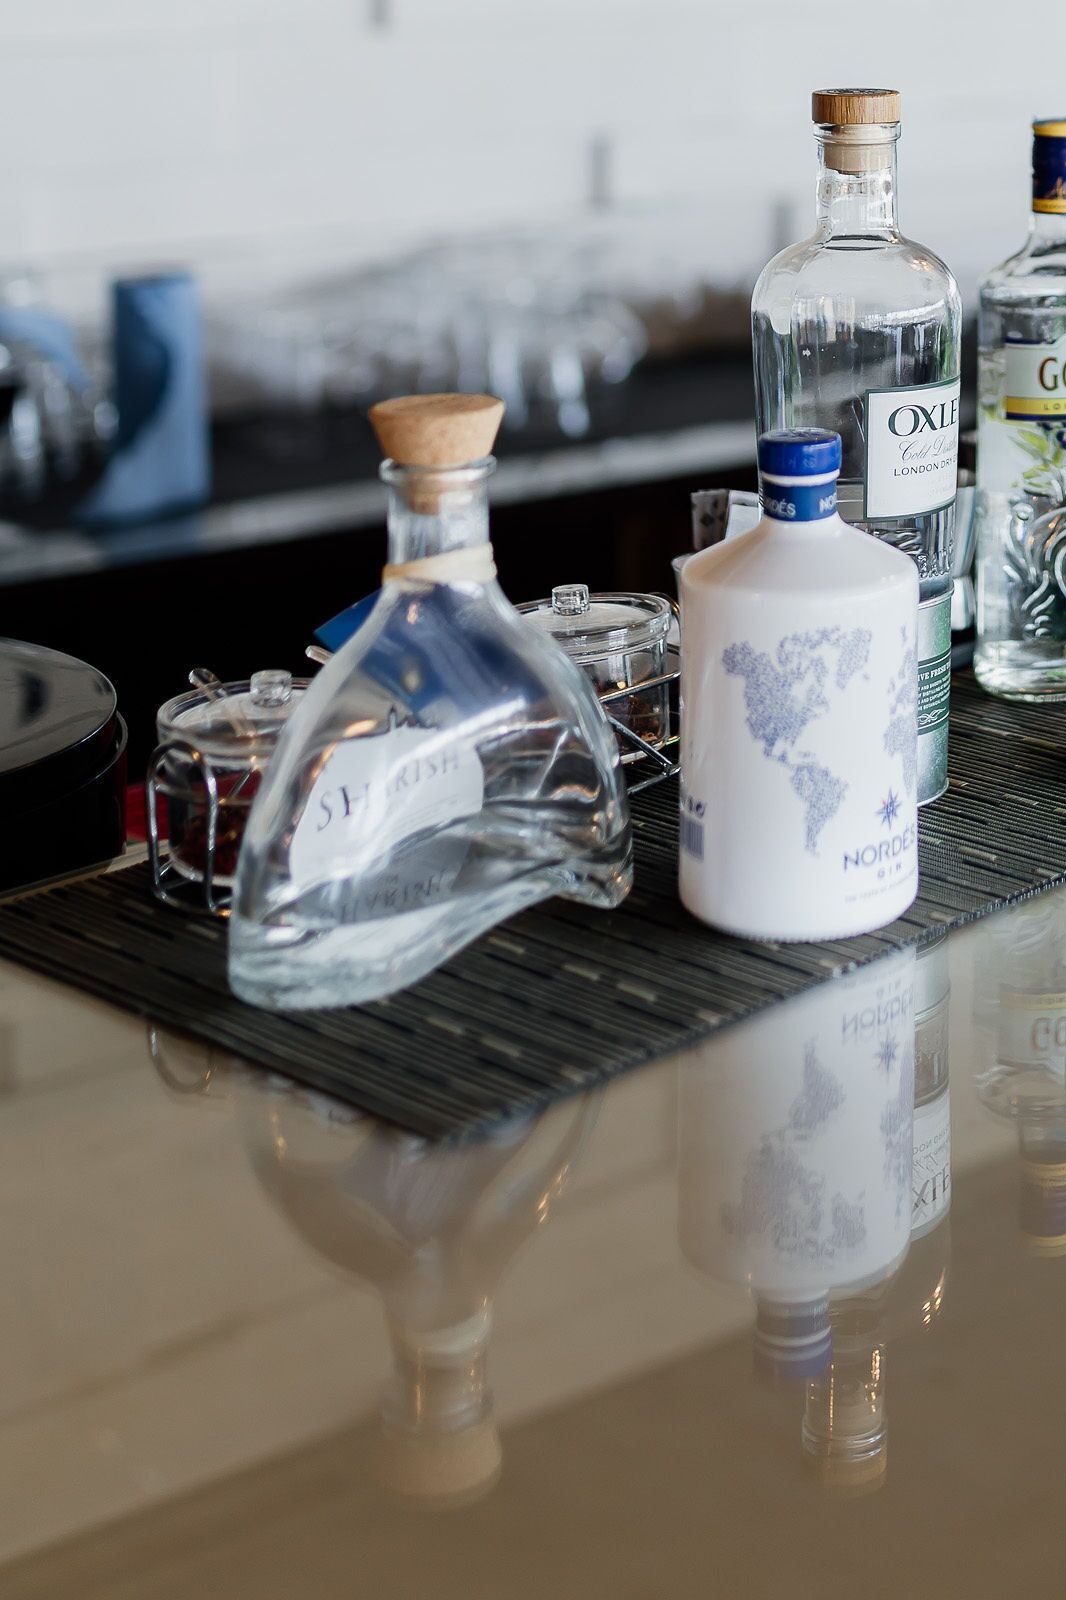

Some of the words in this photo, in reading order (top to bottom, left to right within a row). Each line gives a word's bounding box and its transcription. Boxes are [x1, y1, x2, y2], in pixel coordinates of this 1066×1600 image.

[887, 396, 957, 437] OXLE
[898, 439, 932, 463] Cold
[894, 462, 939, 477] LONDON
[316, 749, 460, 833] SHRISH
